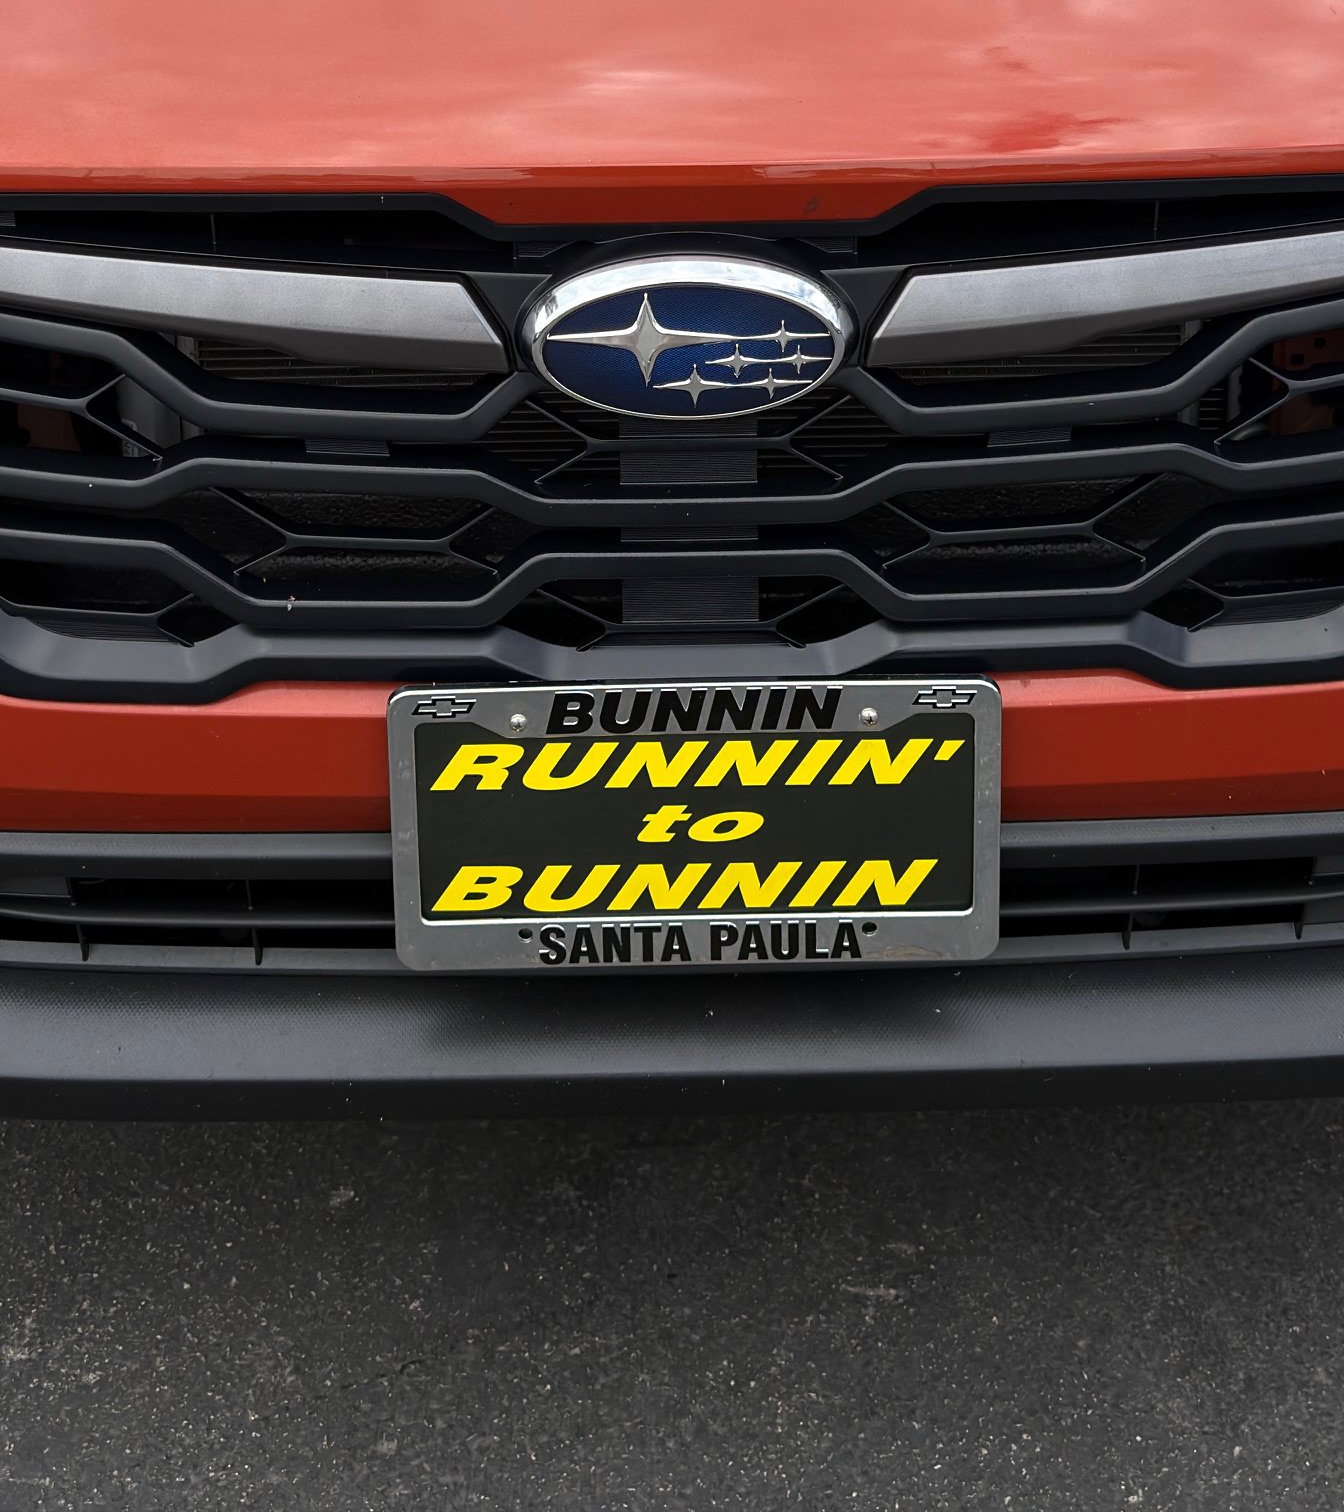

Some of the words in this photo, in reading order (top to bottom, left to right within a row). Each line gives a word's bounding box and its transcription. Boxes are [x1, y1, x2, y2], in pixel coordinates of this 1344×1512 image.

[546, 685, 844, 736] BUNNIN
[429, 738, 966, 791] RUNNIN'
[636, 804, 765, 843] to
[431, 858, 939, 913] BUNNIN
[539, 921, 693, 966] SANTA
[709, 919, 863, 962] PAULA
